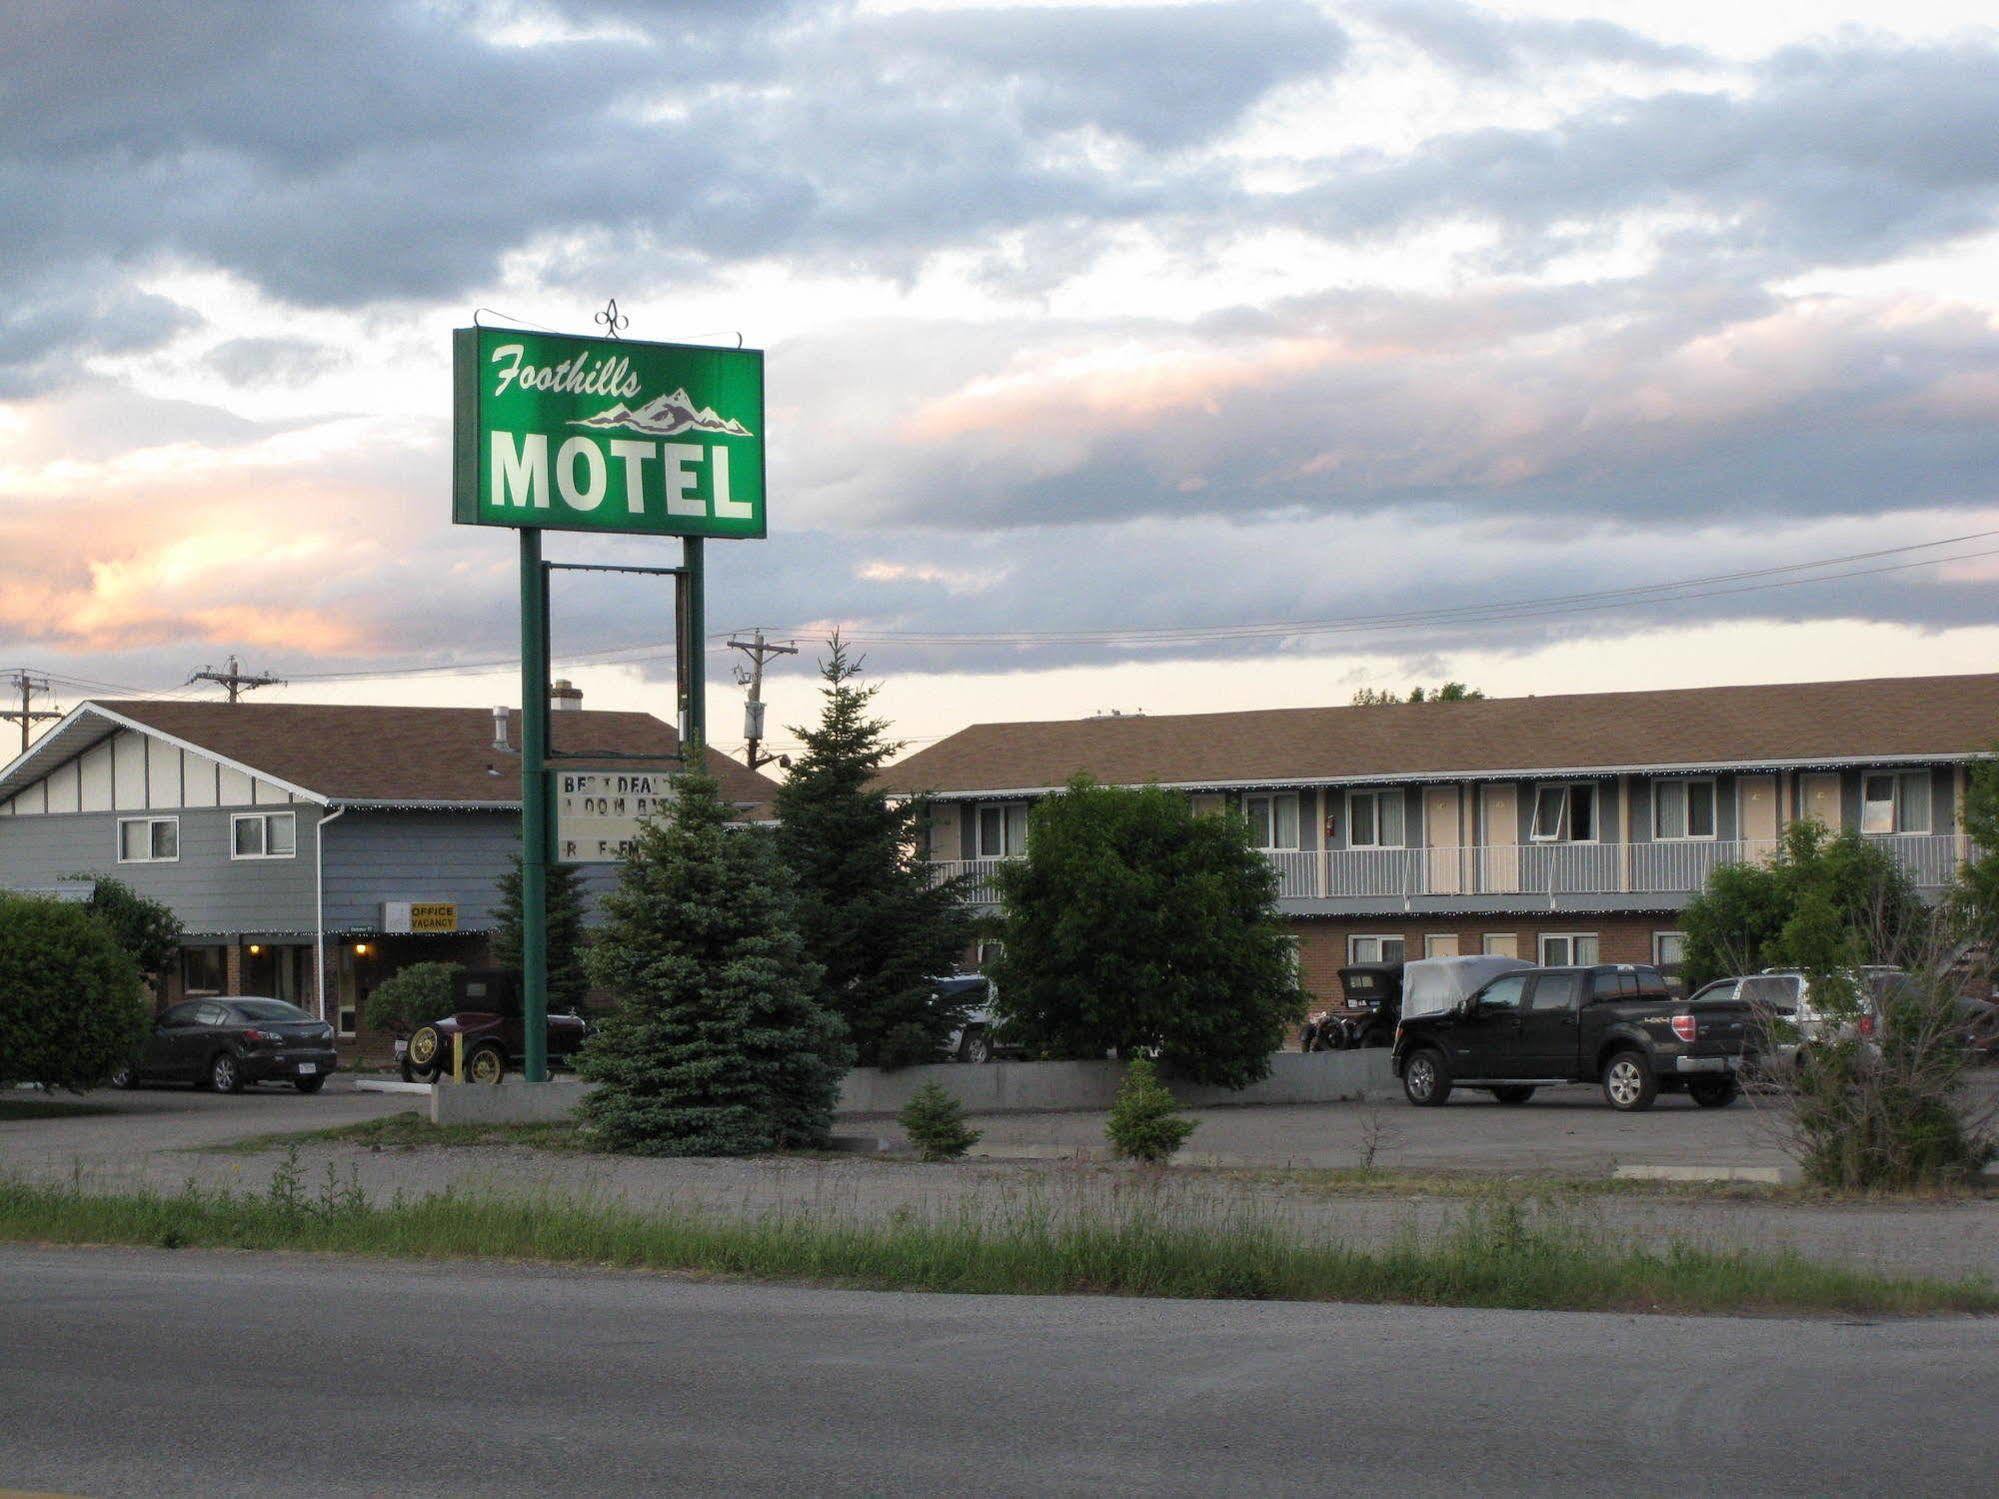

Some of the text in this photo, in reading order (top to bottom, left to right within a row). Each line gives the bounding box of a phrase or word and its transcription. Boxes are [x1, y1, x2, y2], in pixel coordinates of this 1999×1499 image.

[491, 344, 642, 399] Foothills
[491, 430, 753, 520] MOTEL
[564, 776, 611, 793] BE
[411, 906, 454, 917] OFFICE
[411, 918, 454, 929] VACANCY
